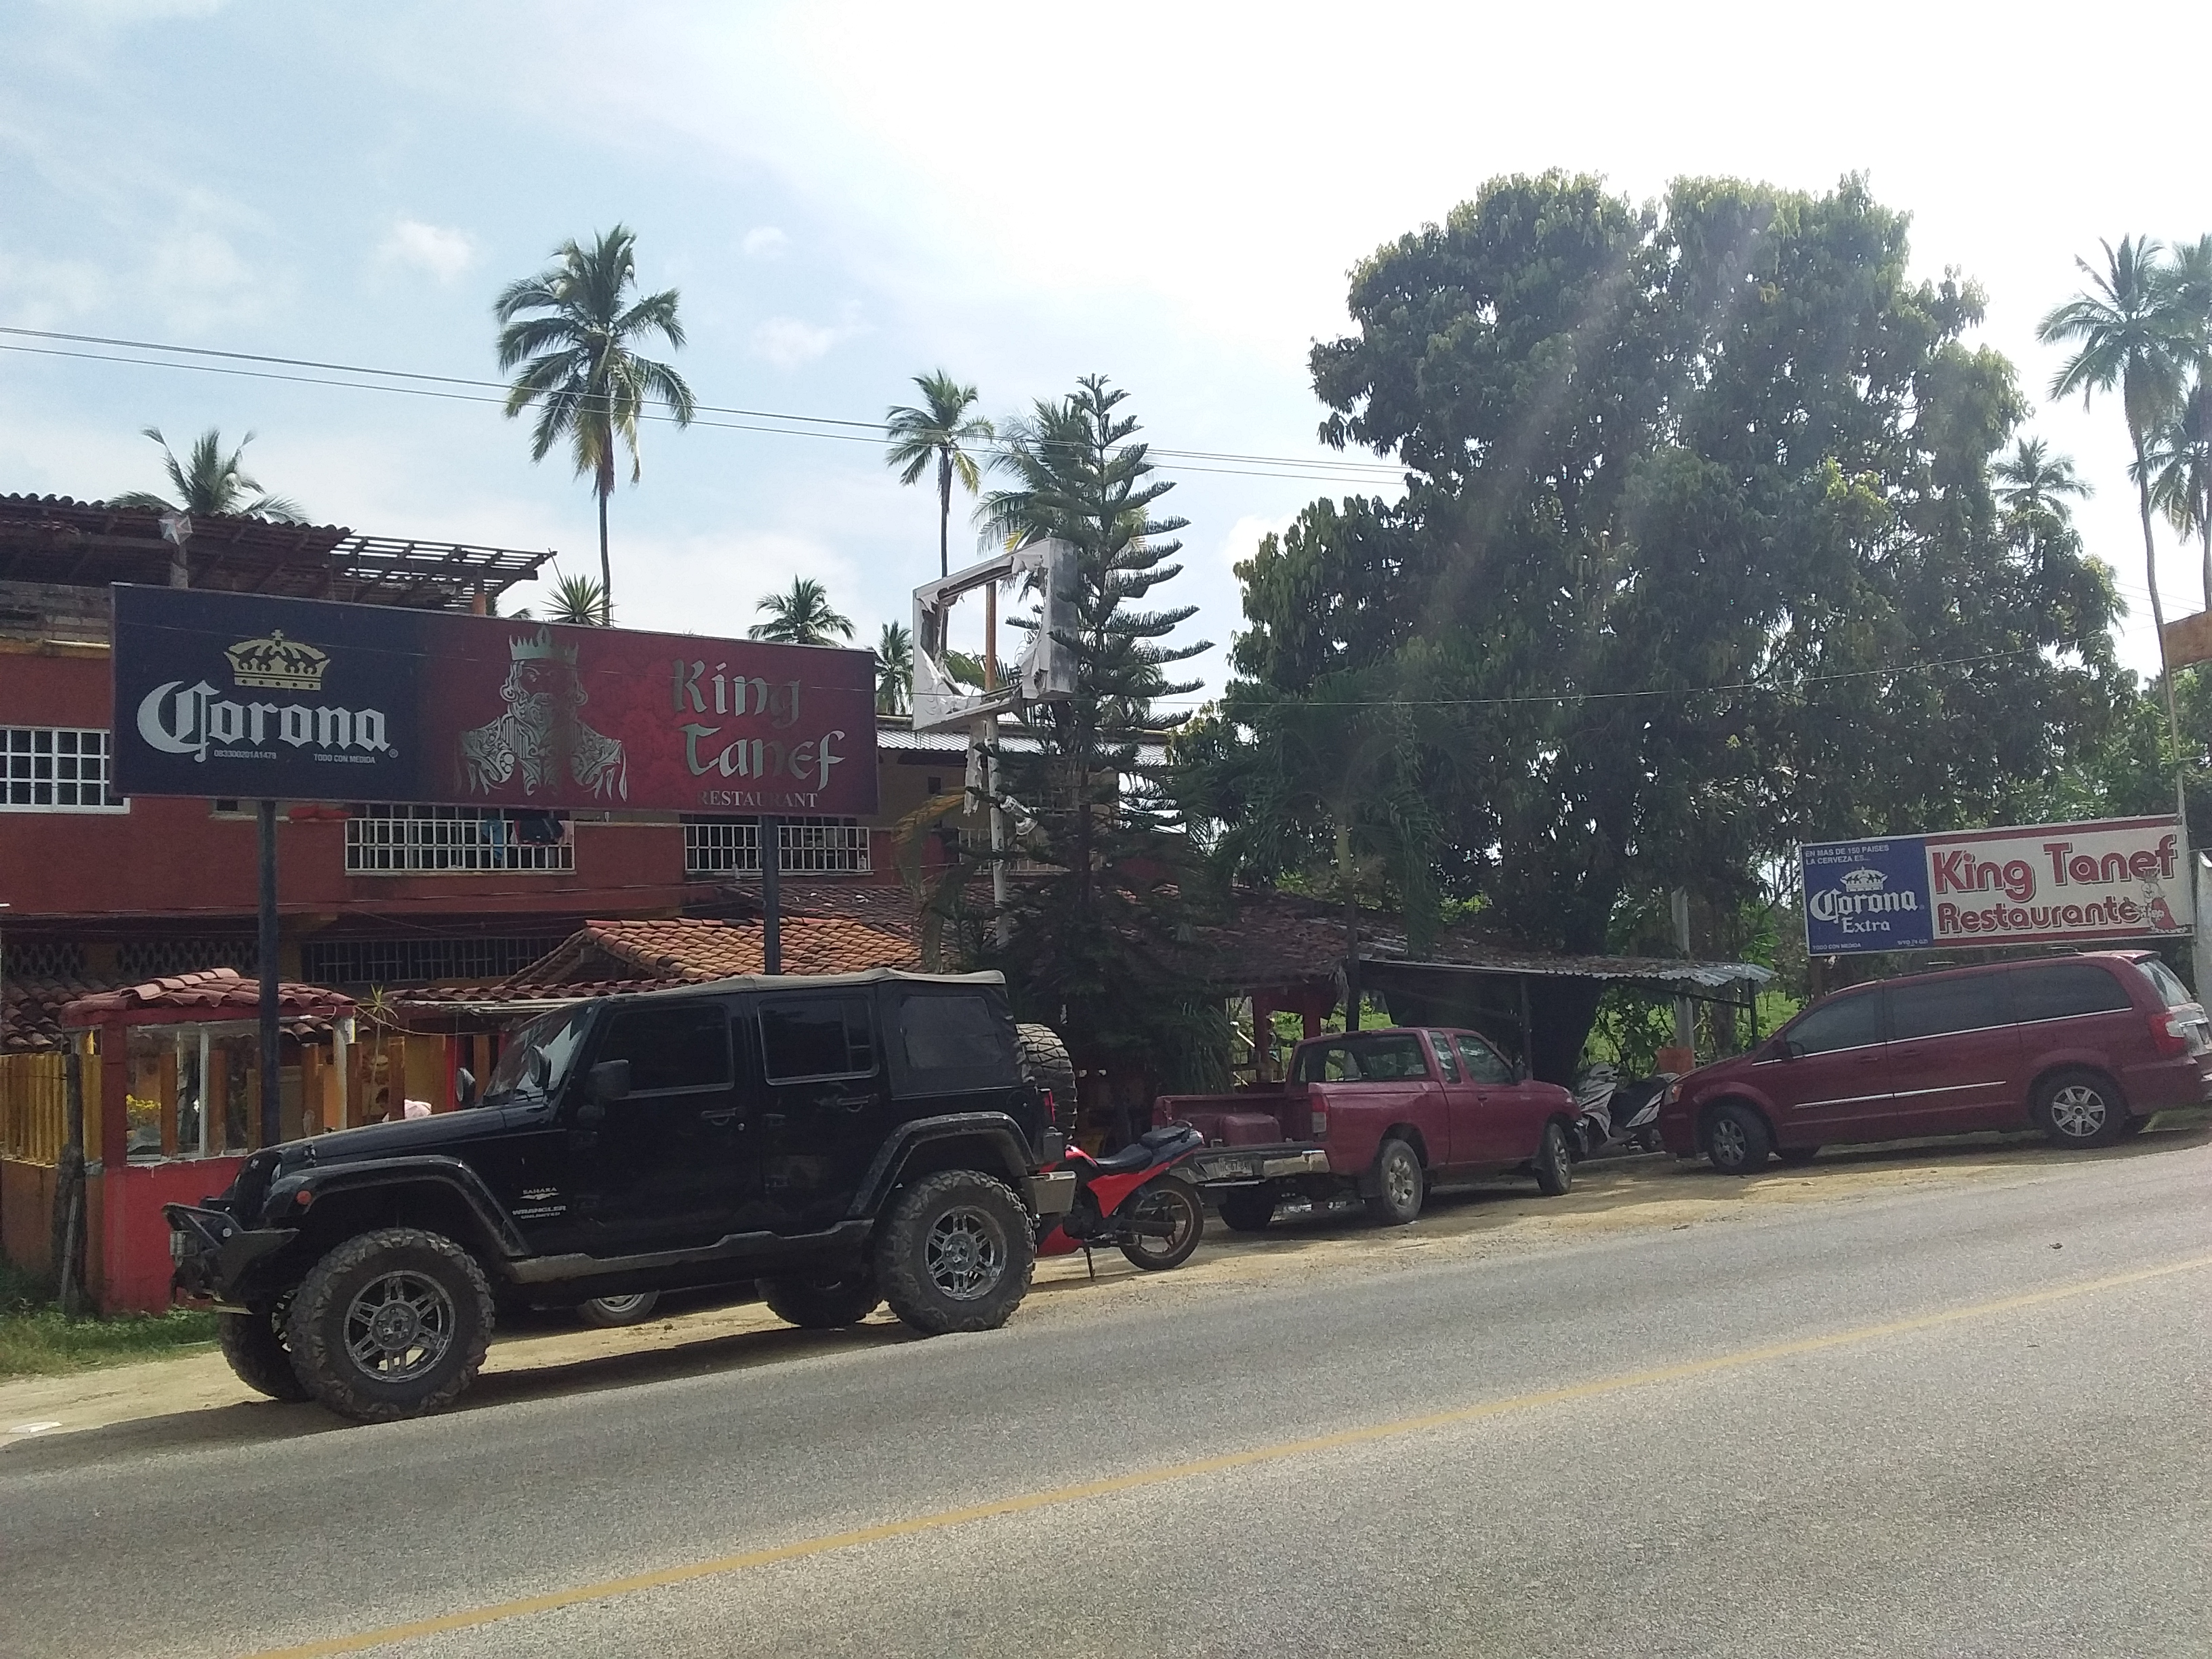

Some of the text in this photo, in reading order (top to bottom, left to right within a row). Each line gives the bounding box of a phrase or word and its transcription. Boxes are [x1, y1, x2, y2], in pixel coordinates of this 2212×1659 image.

[674, 659, 801, 729] King
[137, 680, 390, 763] Corona
[313, 754, 375, 764] TODO CON MEDIDA
[678, 722, 846, 792] Tanef
[1817, 856, 1853, 865] CERVEZA
[1847, 846, 1860, 855] 150
[1862, 844, 1889, 853] PAISES
[1932, 833, 2178, 903] King Tanef
[1809, 888, 1919, 924] Corona
[1841, 916, 1891, 934] Extra
[512, 1206, 567, 1215] WRANGLER
